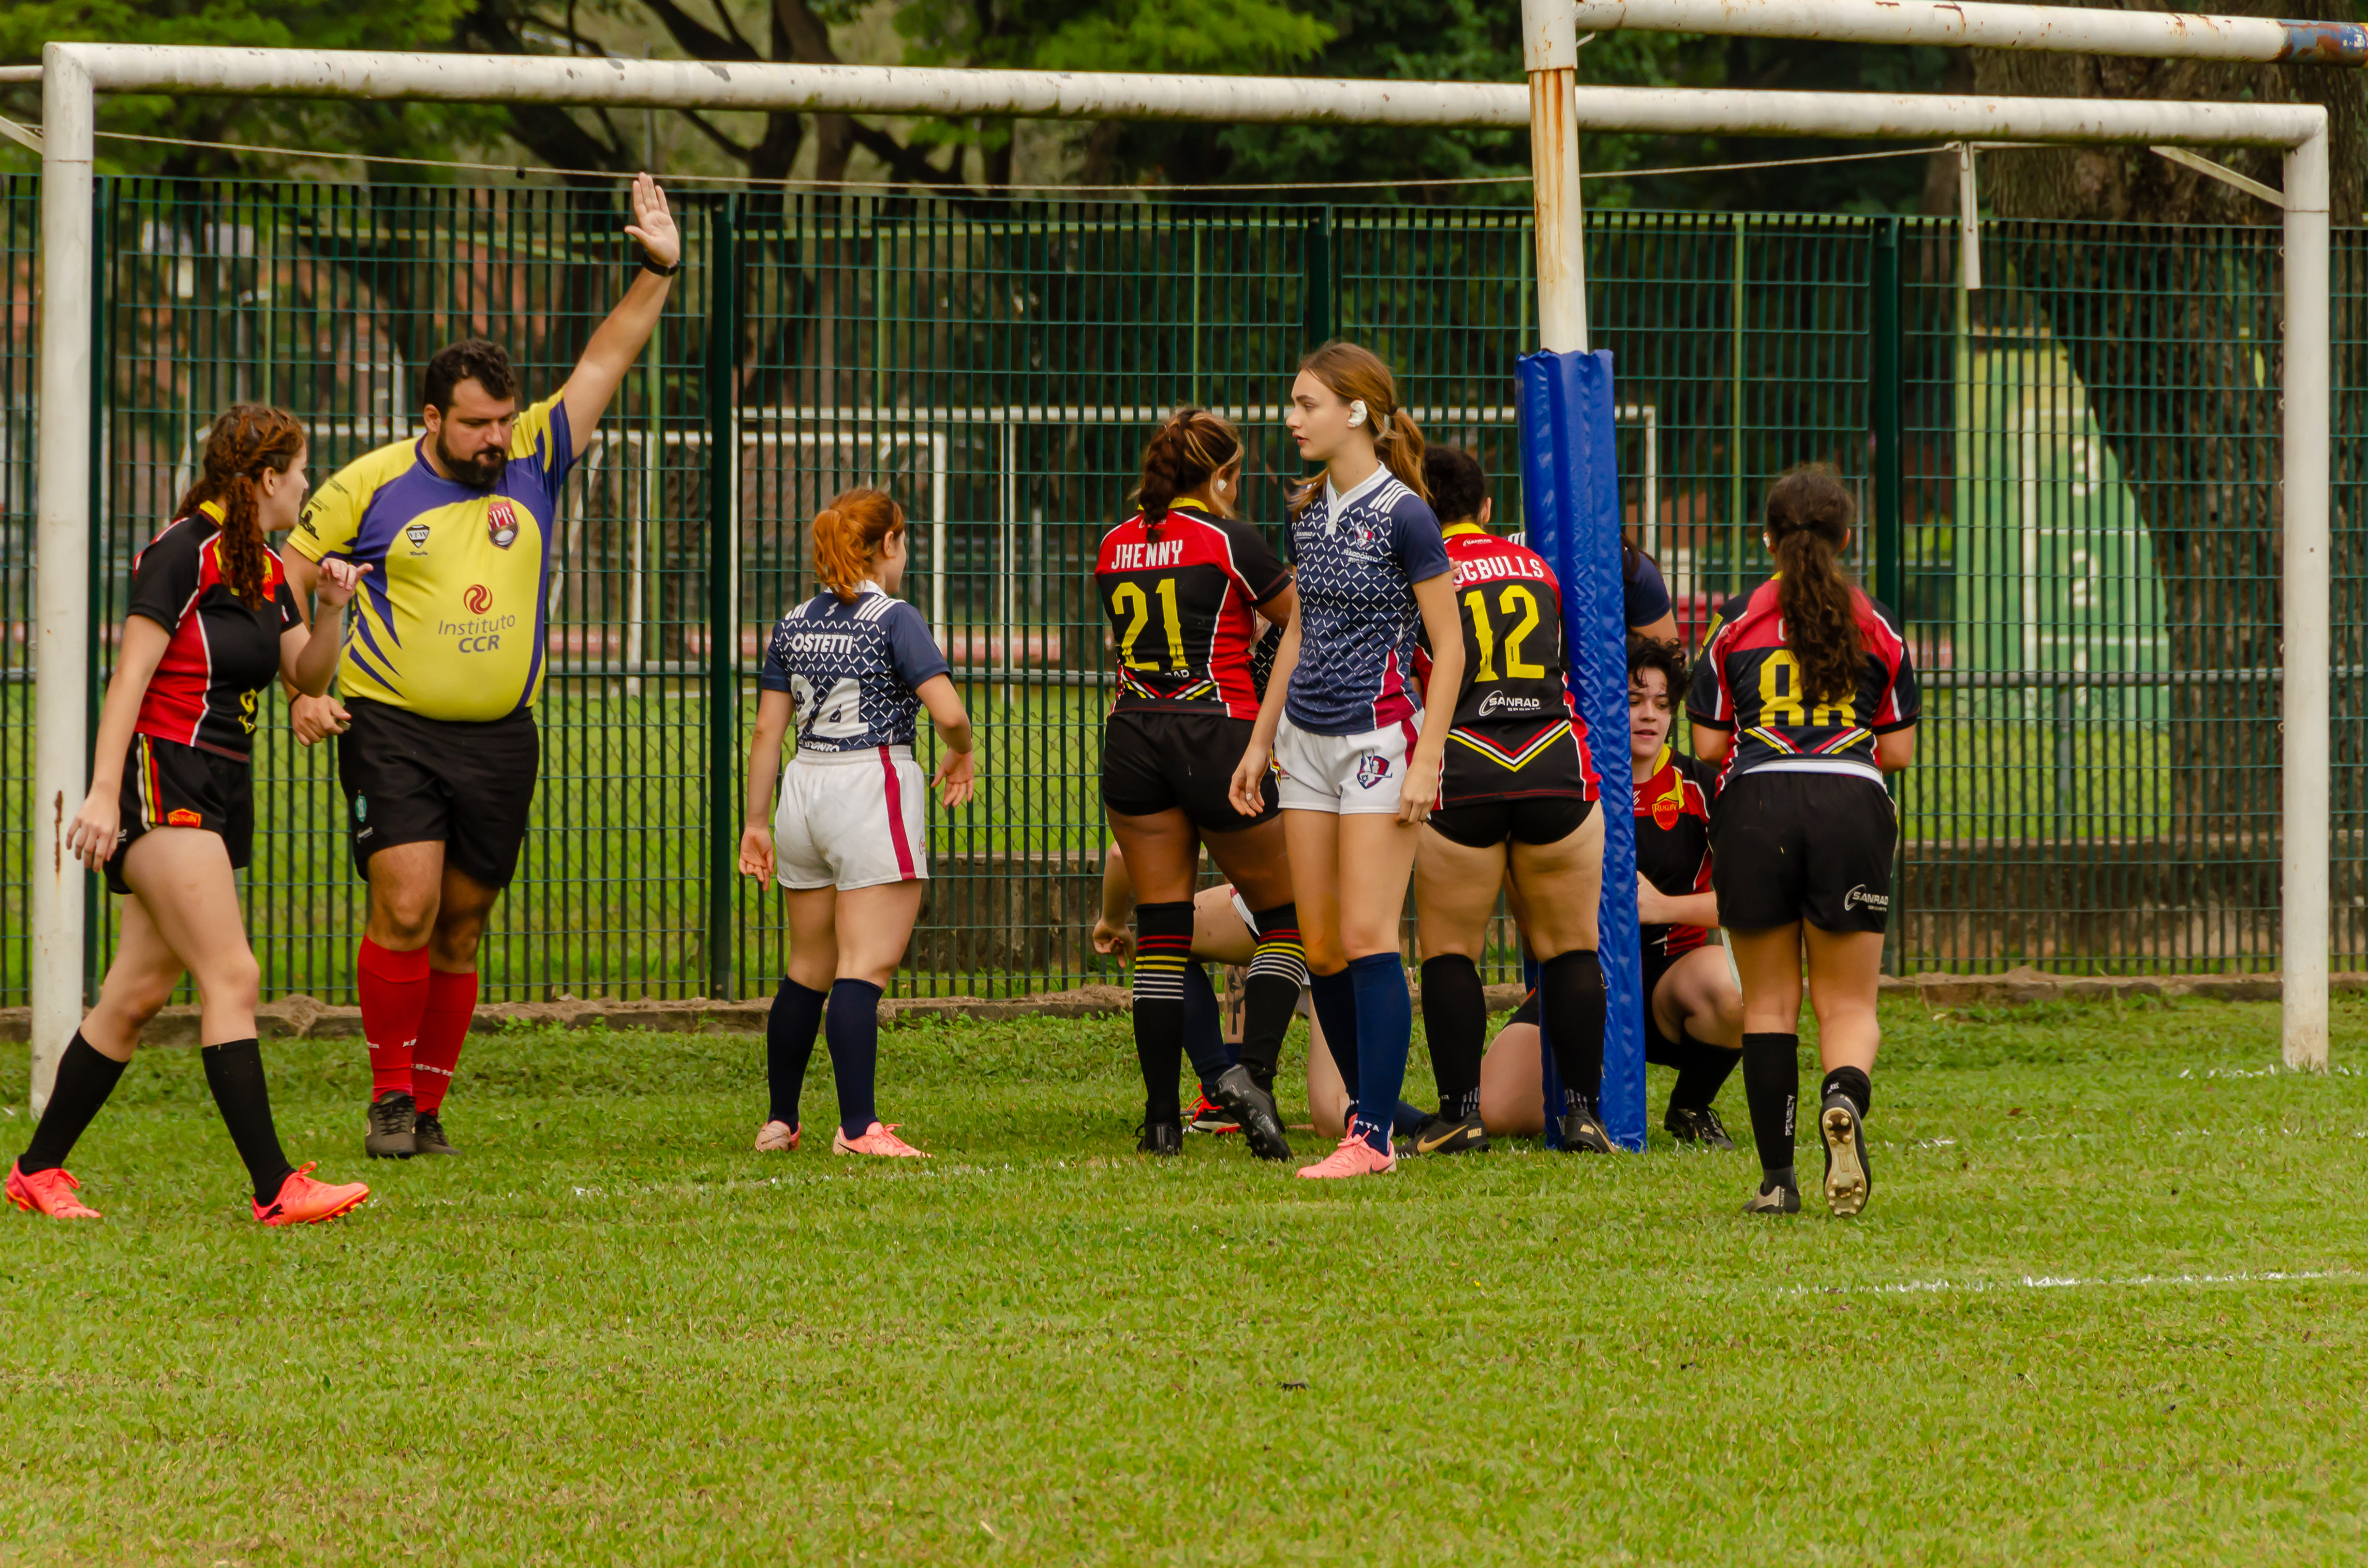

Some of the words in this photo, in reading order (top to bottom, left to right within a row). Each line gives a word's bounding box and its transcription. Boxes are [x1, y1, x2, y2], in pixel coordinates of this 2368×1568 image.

[1111, 540, 1183, 570] JHENNY
[438, 615, 516, 635] Instituto
[1111, 578, 1191, 671] 21
[1464, 585, 1545, 683] 12
[458, 634, 500, 654] CCR
[792, 633, 853, 654] OSTETTI
[1489, 697, 1540, 707] SANRAD
[1655, 803, 1677, 813] RUGBY
[1852, 892, 1888, 905] SANRAD
